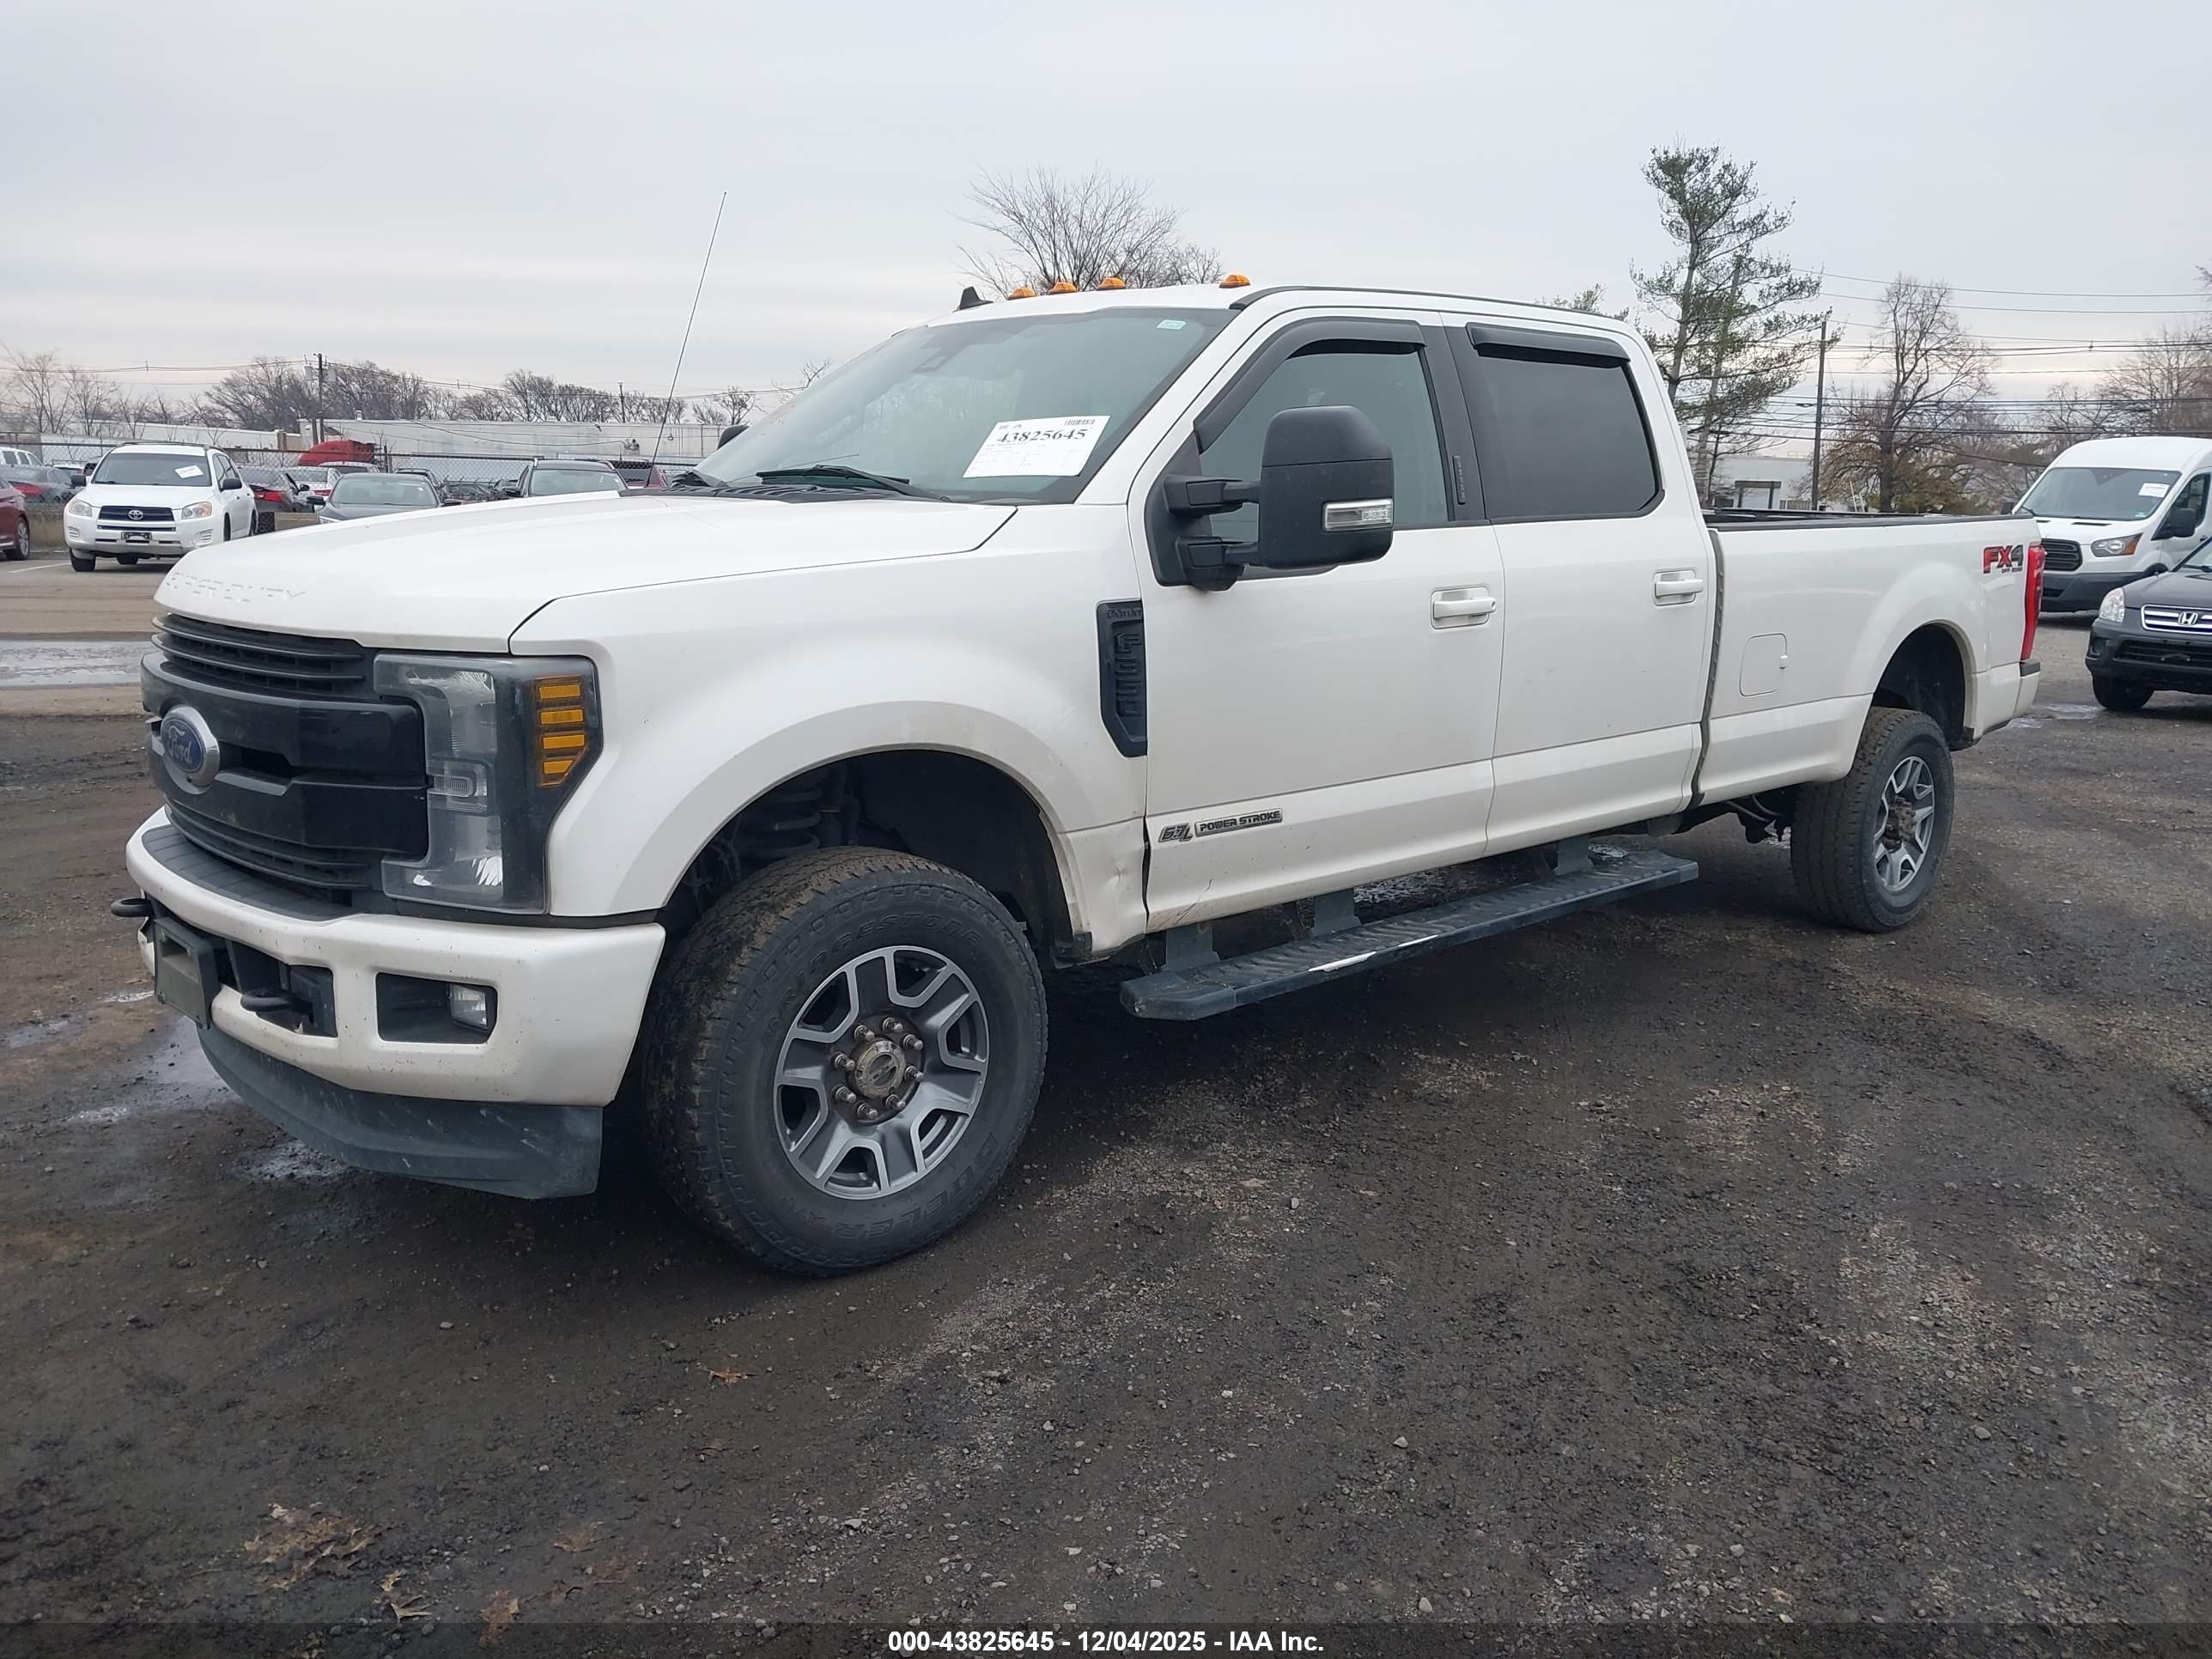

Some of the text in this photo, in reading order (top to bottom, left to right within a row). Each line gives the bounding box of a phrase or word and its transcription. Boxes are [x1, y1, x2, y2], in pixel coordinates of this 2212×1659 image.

[996, 428, 1089, 443] 43825645
[1983, 544, 2024, 574] FX4
[167, 724, 193, 764] Ford
[1200, 817, 1237, 832] POWER
[1238, 810, 1280, 824] STROKE
[830, 1130, 998, 1242] DUELER
